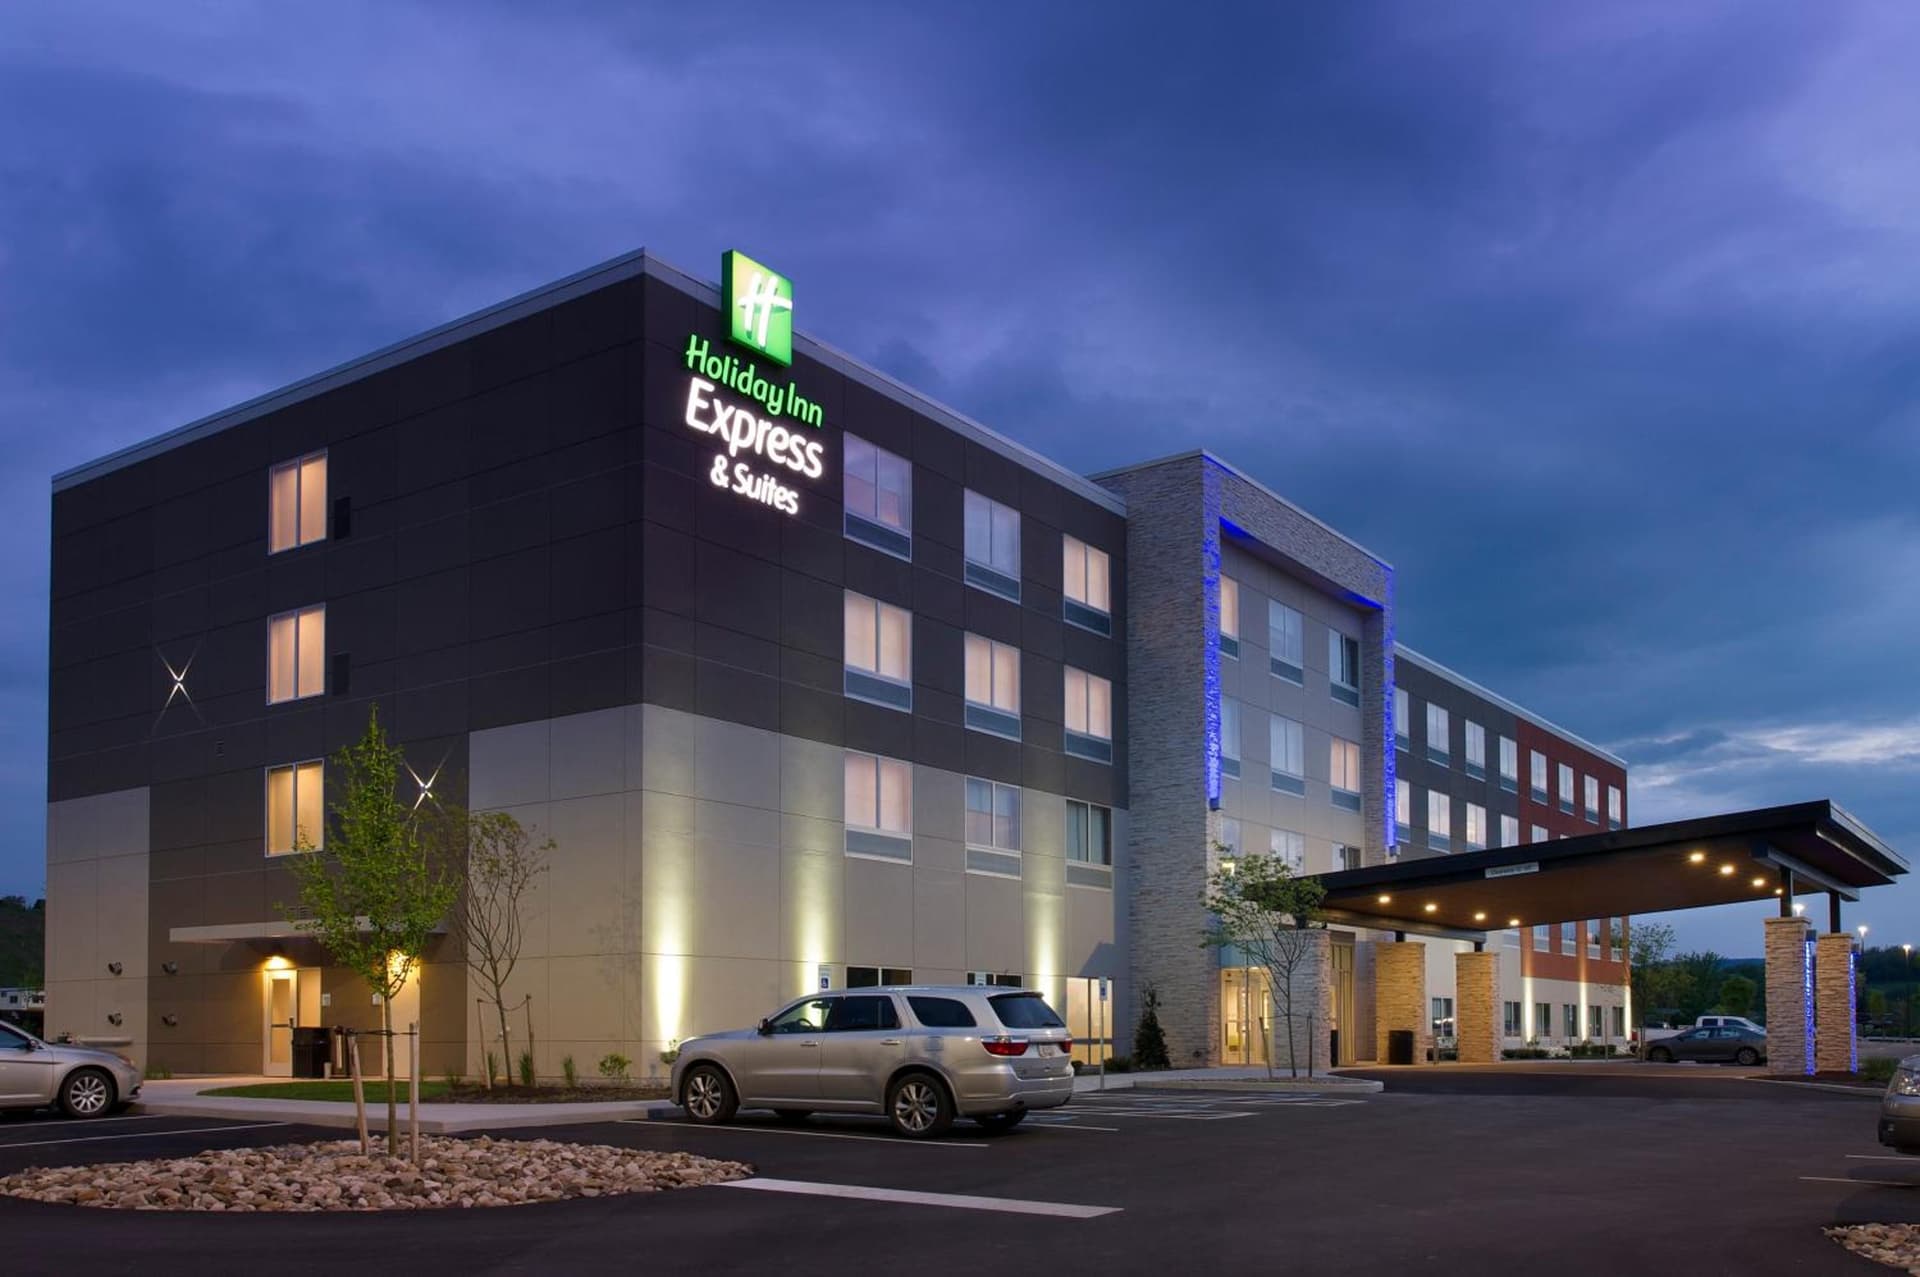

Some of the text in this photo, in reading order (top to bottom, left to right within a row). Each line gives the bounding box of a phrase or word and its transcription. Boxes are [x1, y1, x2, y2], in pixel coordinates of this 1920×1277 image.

[685, 376, 824, 479] Express
[686, 334, 823, 428] Holiday Inn
[710, 455, 799, 516] & Suites
